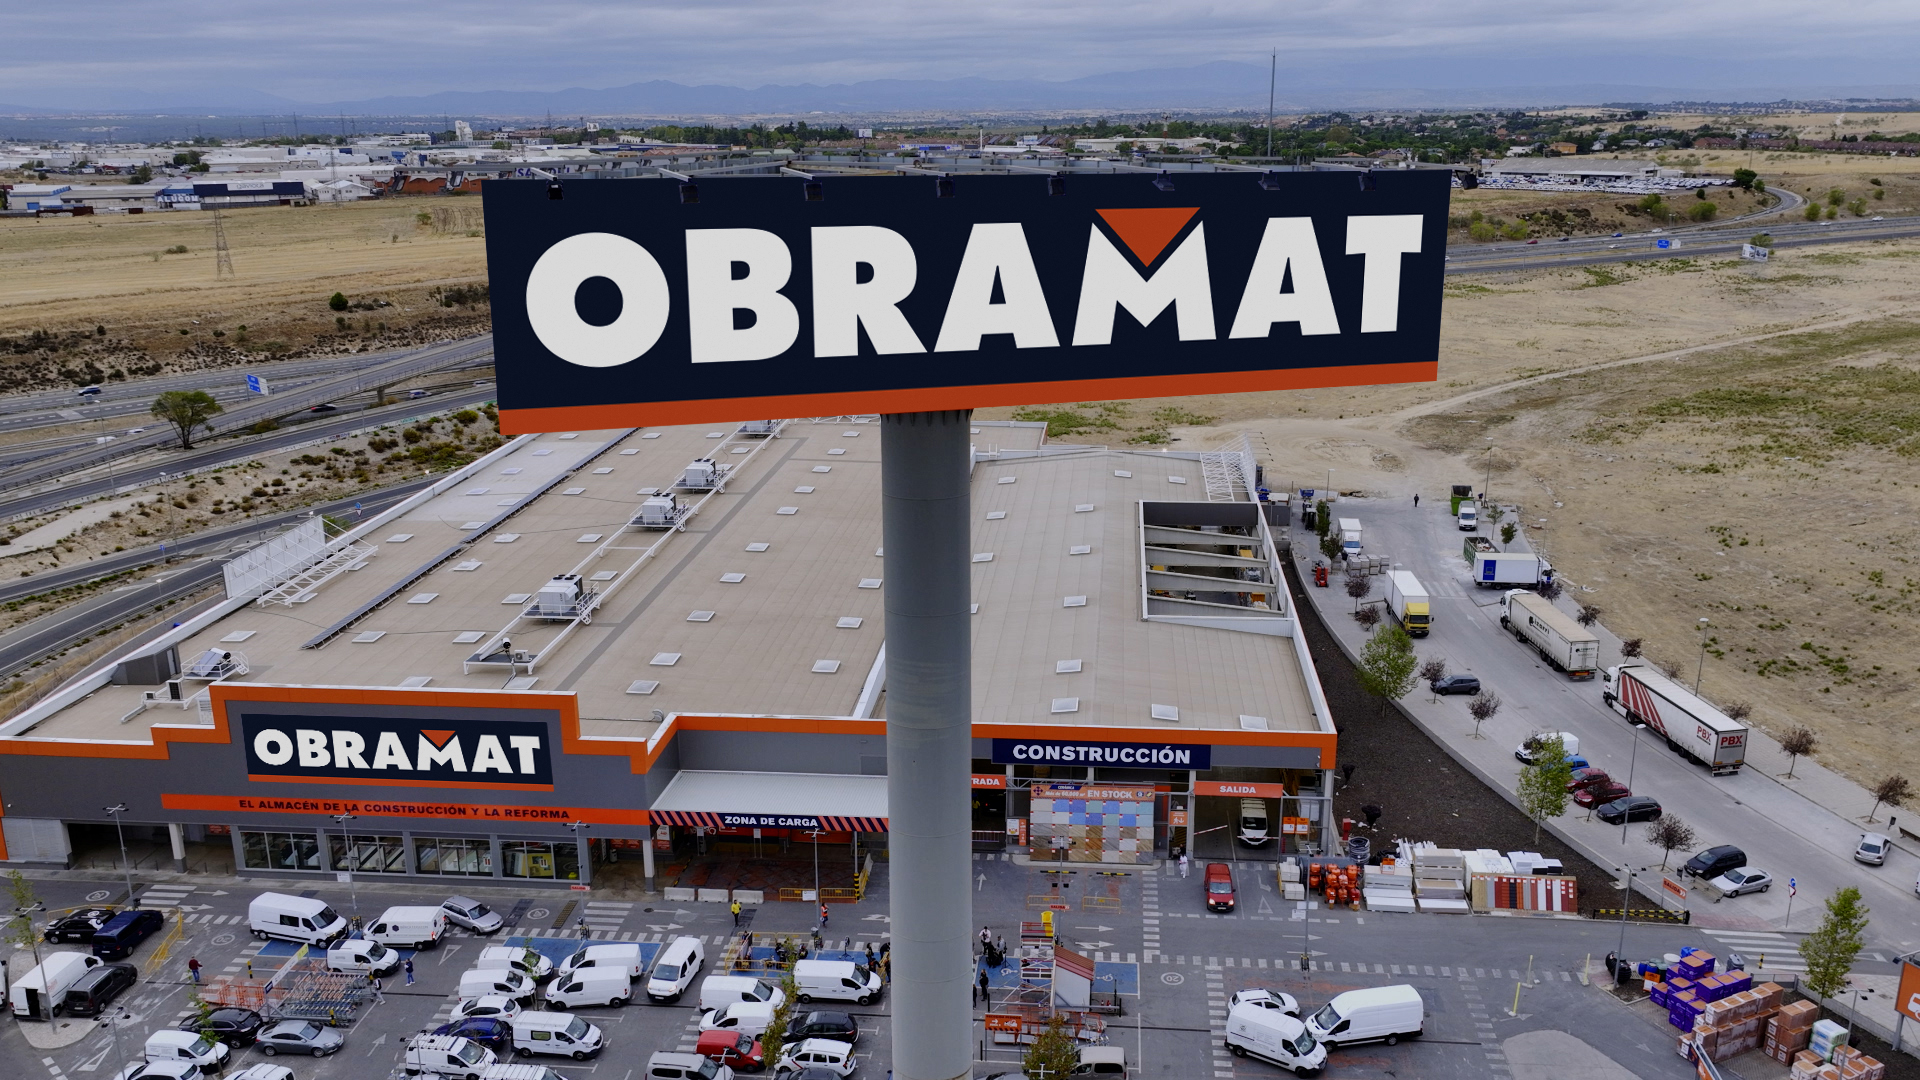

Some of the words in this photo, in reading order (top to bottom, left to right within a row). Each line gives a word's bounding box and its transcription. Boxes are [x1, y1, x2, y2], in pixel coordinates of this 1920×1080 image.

[525, 208, 1425, 368] OBRAMAT
[1696, 725, 1712, 743] PBX
[1720, 735, 1743, 746] PBX
[253, 728, 541, 775] OBRAMAT
[1011, 744, 1192, 765] CONSTRUCCIÓN
[1087, 790, 1100, 798] EN
[1101, 790, 1132, 798] STOCK
[1219, 785, 1257, 794] SALIDA
[239, 799, 254, 808] EL
[258, 800, 319, 810] ALMACÉN
[323, 802, 340, 811] DE
[344, 803, 359, 812] LA
[364, 804, 467, 816] CONSTRUCCIÓN
[471, 807, 480, 816] Y
[484, 808, 500, 817] LA
[505, 809, 570, 819] REFORMA
[724, 816, 757, 825] ZONA
[760, 817, 775, 826] DE
[778, 817, 818, 827] CARGA
[1663, 880, 1681, 894] SALIDA
